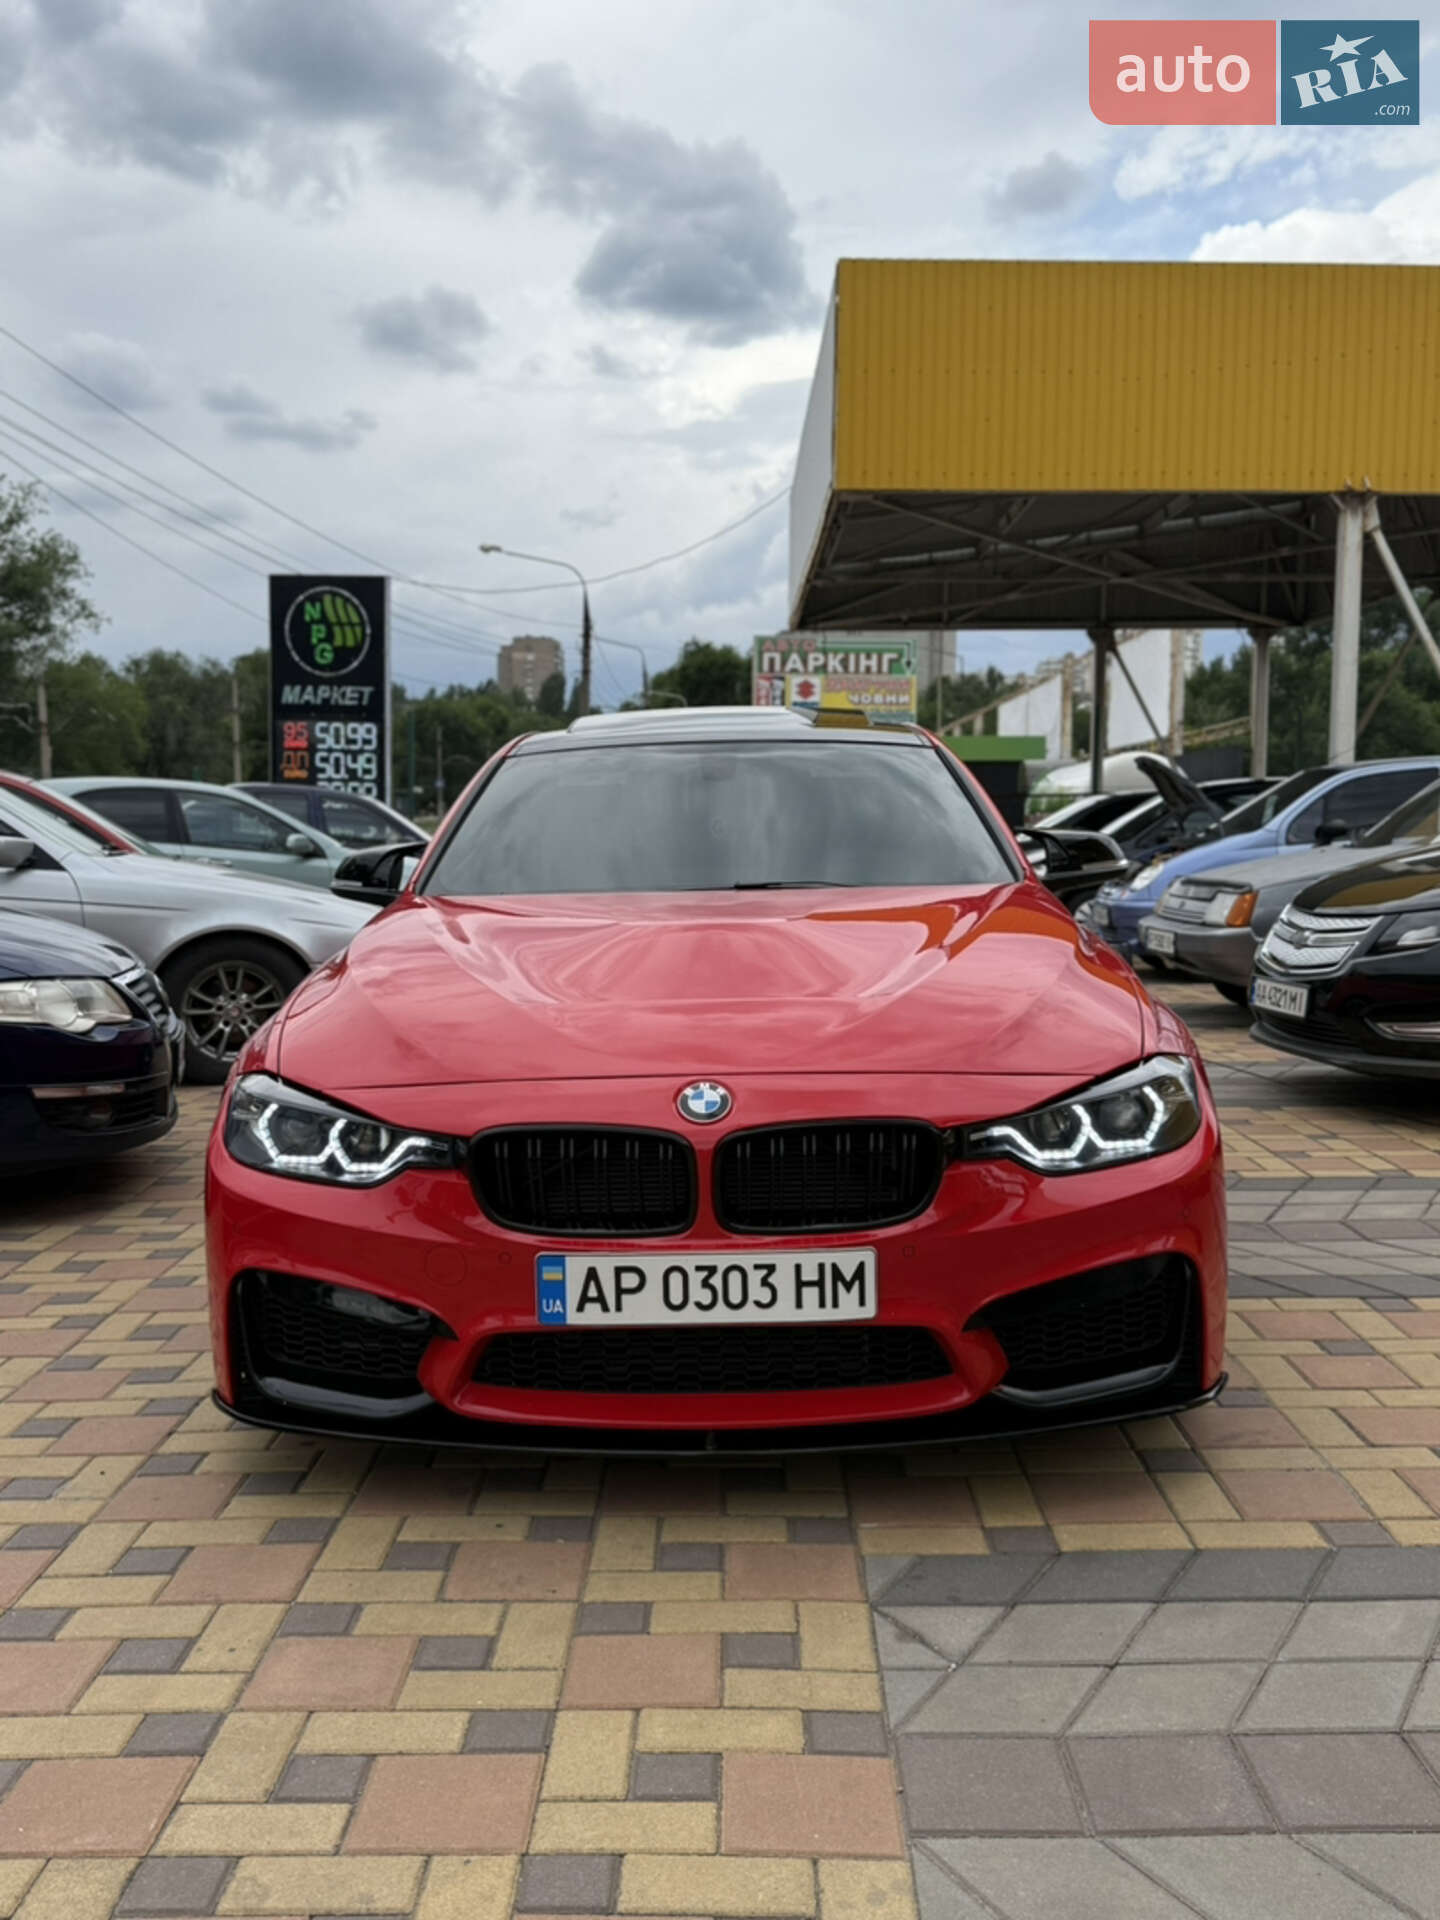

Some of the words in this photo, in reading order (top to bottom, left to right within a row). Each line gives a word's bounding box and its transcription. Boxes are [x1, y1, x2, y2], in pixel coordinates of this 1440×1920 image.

[304, 601, 334, 664] NPG
[762, 652, 898, 673] ПАРКІНГ
[281, 685, 374, 705] МАРКЕТ
[283, 721, 309, 741] 95
[315, 722, 378, 750] 50.99
[315, 752, 378, 780] 50.49
[683, 1082, 726, 1096] BMW
[575, 1265, 647, 1313] AP
[662, 1263, 778, 1312] 0303
[794, 1260, 866, 1310] HM
[542, 1299, 564, 1313] UA
